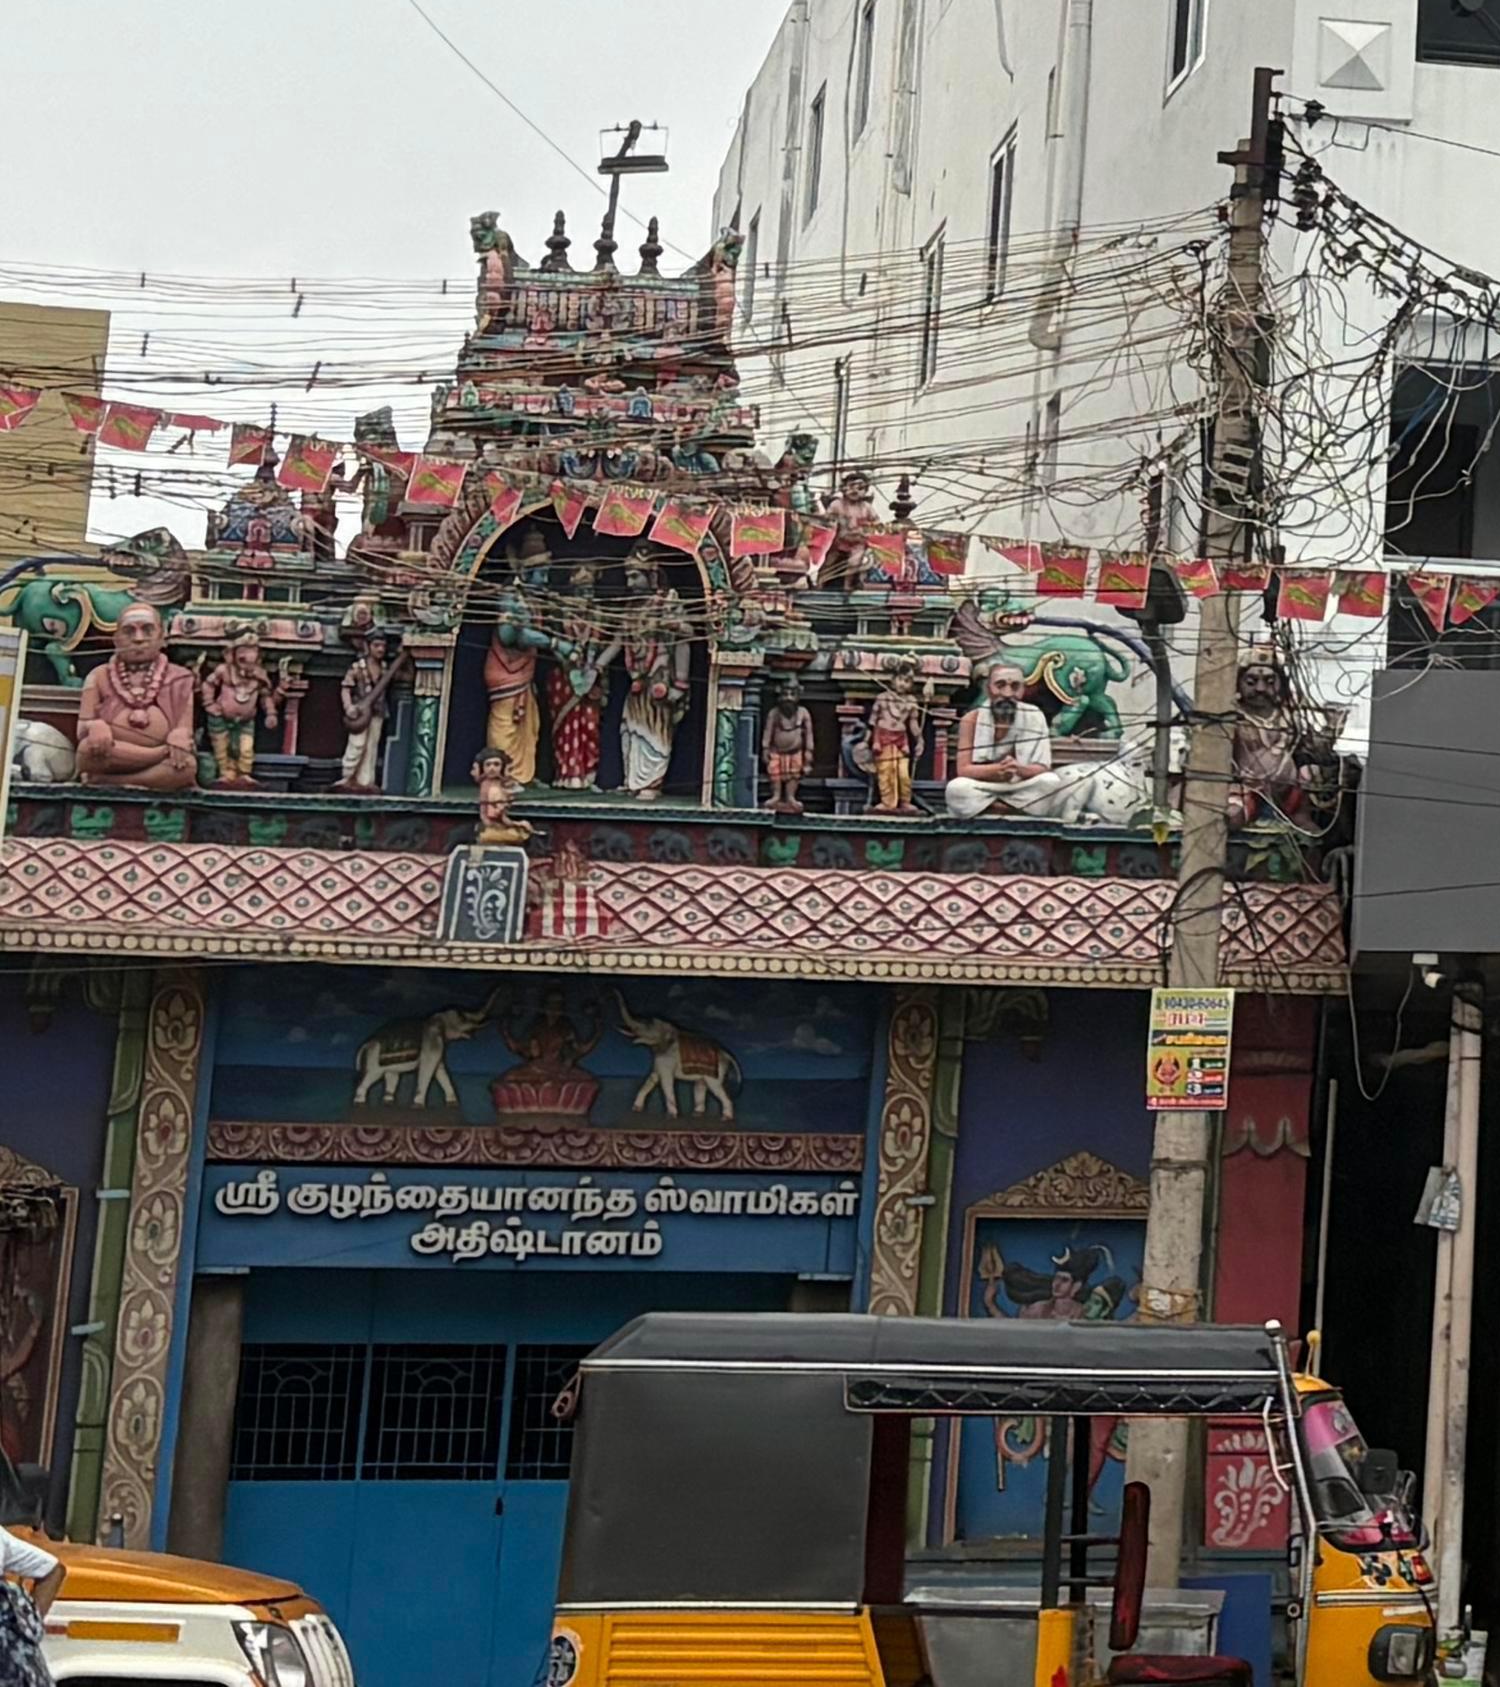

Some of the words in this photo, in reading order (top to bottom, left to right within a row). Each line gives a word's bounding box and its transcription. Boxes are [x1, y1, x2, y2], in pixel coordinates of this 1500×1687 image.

[214, 1169, 280, 1215] ஸ்ரீ
[286, 1172, 638, 1222] குழந்தையானந்த
[643, 1174, 859, 1219] ஸ்வாமிகள்
[409, 1216, 664, 1263] அதிஷ்டானம்
